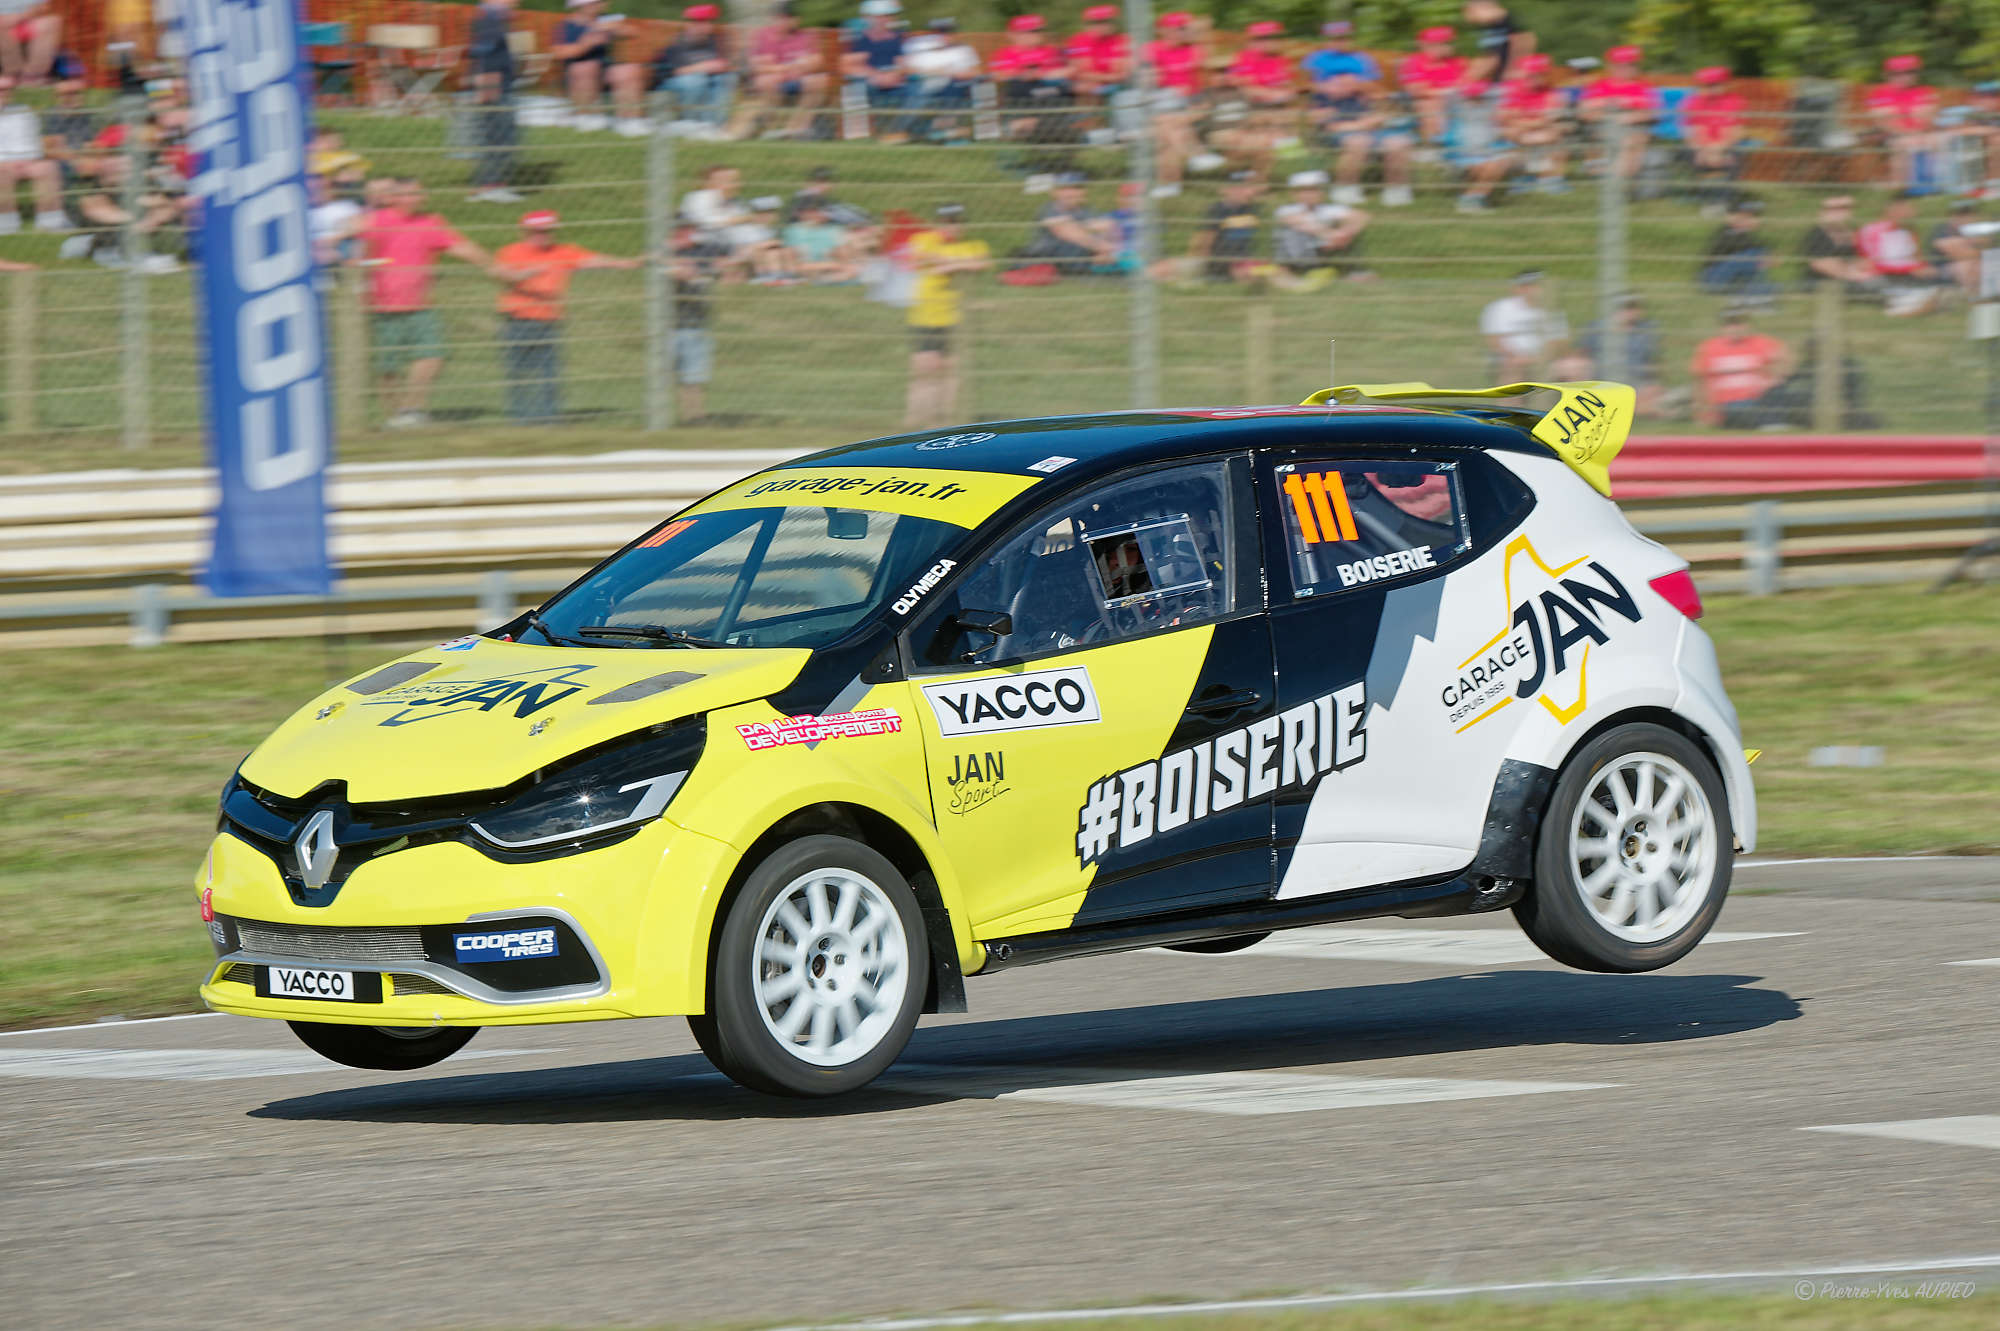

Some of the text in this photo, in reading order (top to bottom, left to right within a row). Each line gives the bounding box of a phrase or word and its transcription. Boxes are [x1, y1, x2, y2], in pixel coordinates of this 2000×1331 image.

[1553, 391, 1606, 444] JAN
[744, 476, 967, 500] garage-jan.fr
[1283, 471, 1359, 543] 111
[1336, 546, 1437, 587] BOISERIE
[891, 558, 957, 616] OLYMECA
[1442, 561, 1643, 708] GARAGE JAN
[408, 679, 583, 719] JAN
[938, 678, 1086, 724] YACCO
[1449, 694, 1485, 723] DEPUIS
[736, 723, 772, 737] DA
[774, 714, 818, 730] LUZ
[744, 717, 901, 749] DEVELOPPEMENT
[947, 751, 1004, 785] JAN
[1078, 681, 1366, 861] #BOISERIE
[948, 780, 1010, 816] Sport
[455, 929, 556, 951] COOPER
[501, 944, 555, 959] TIRES
[278, 970, 344, 995] YACCO
